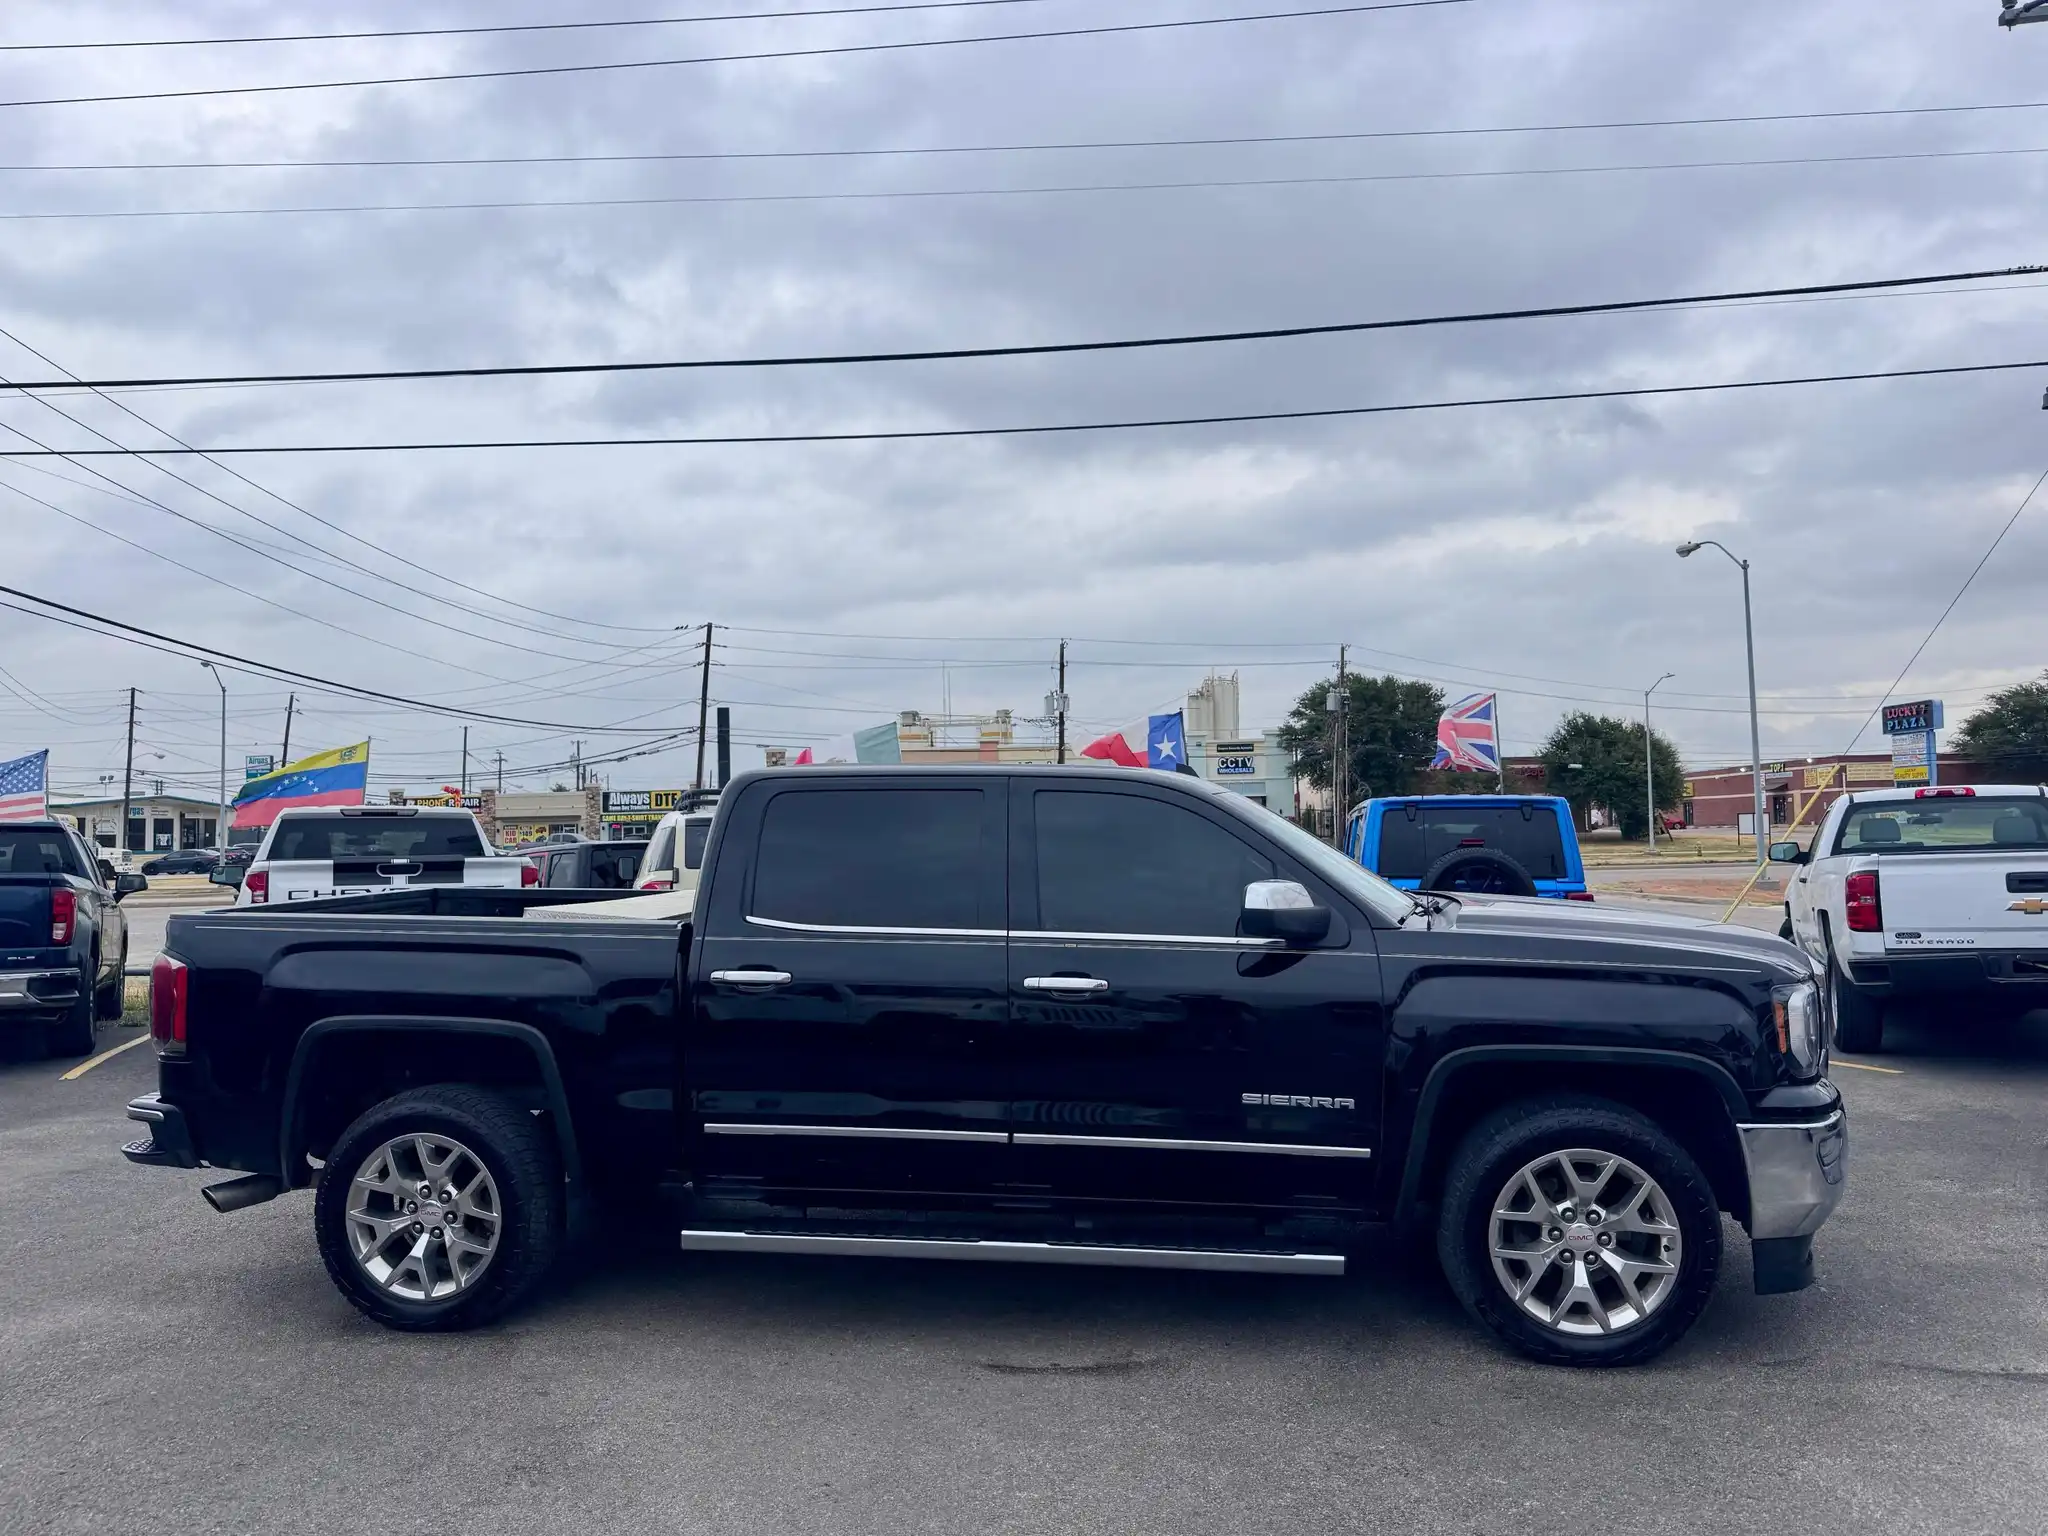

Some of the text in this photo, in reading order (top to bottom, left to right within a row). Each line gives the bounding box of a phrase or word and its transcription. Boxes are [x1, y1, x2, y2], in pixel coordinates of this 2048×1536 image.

[1887, 706, 1918, 718] LUCKY
[1887, 717, 1926, 730] PLAZA
[1219, 757, 1253, 768] CCTV
[417, 799, 446, 807] PHONE
[448, 798, 480, 807] RPAIR
[609, 792, 650, 805] Always
[129, 807, 145, 816] rgas
[1242, 1093, 1355, 1109] SIERRA
